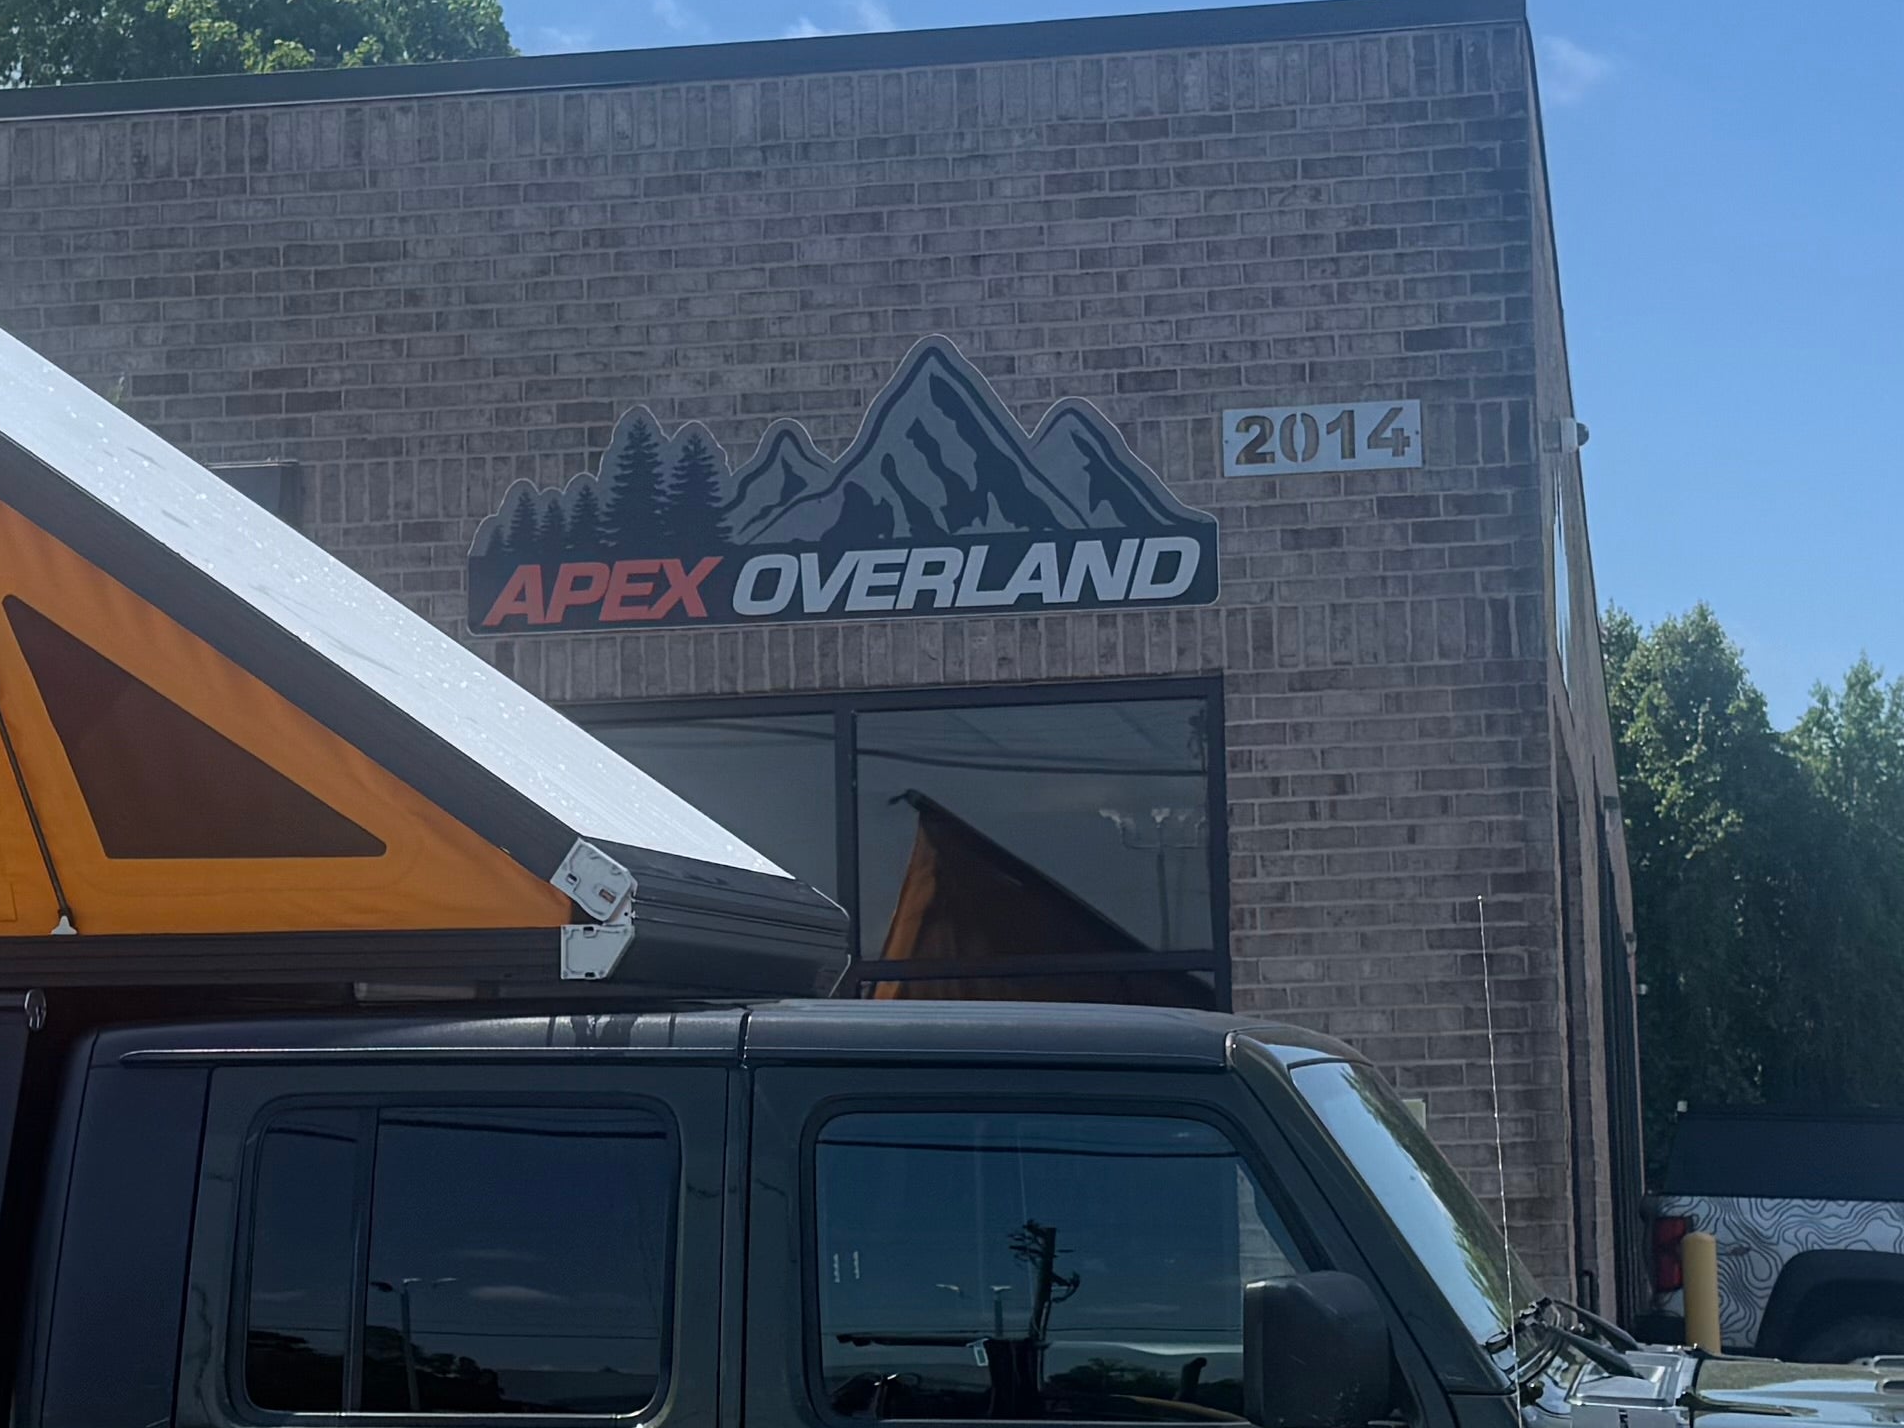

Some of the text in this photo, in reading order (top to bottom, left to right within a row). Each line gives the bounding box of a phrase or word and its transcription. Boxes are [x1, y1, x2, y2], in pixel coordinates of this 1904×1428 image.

[1232, 405, 1414, 468] 2014
[480, 535, 1203, 627] APEX OVERLAND
